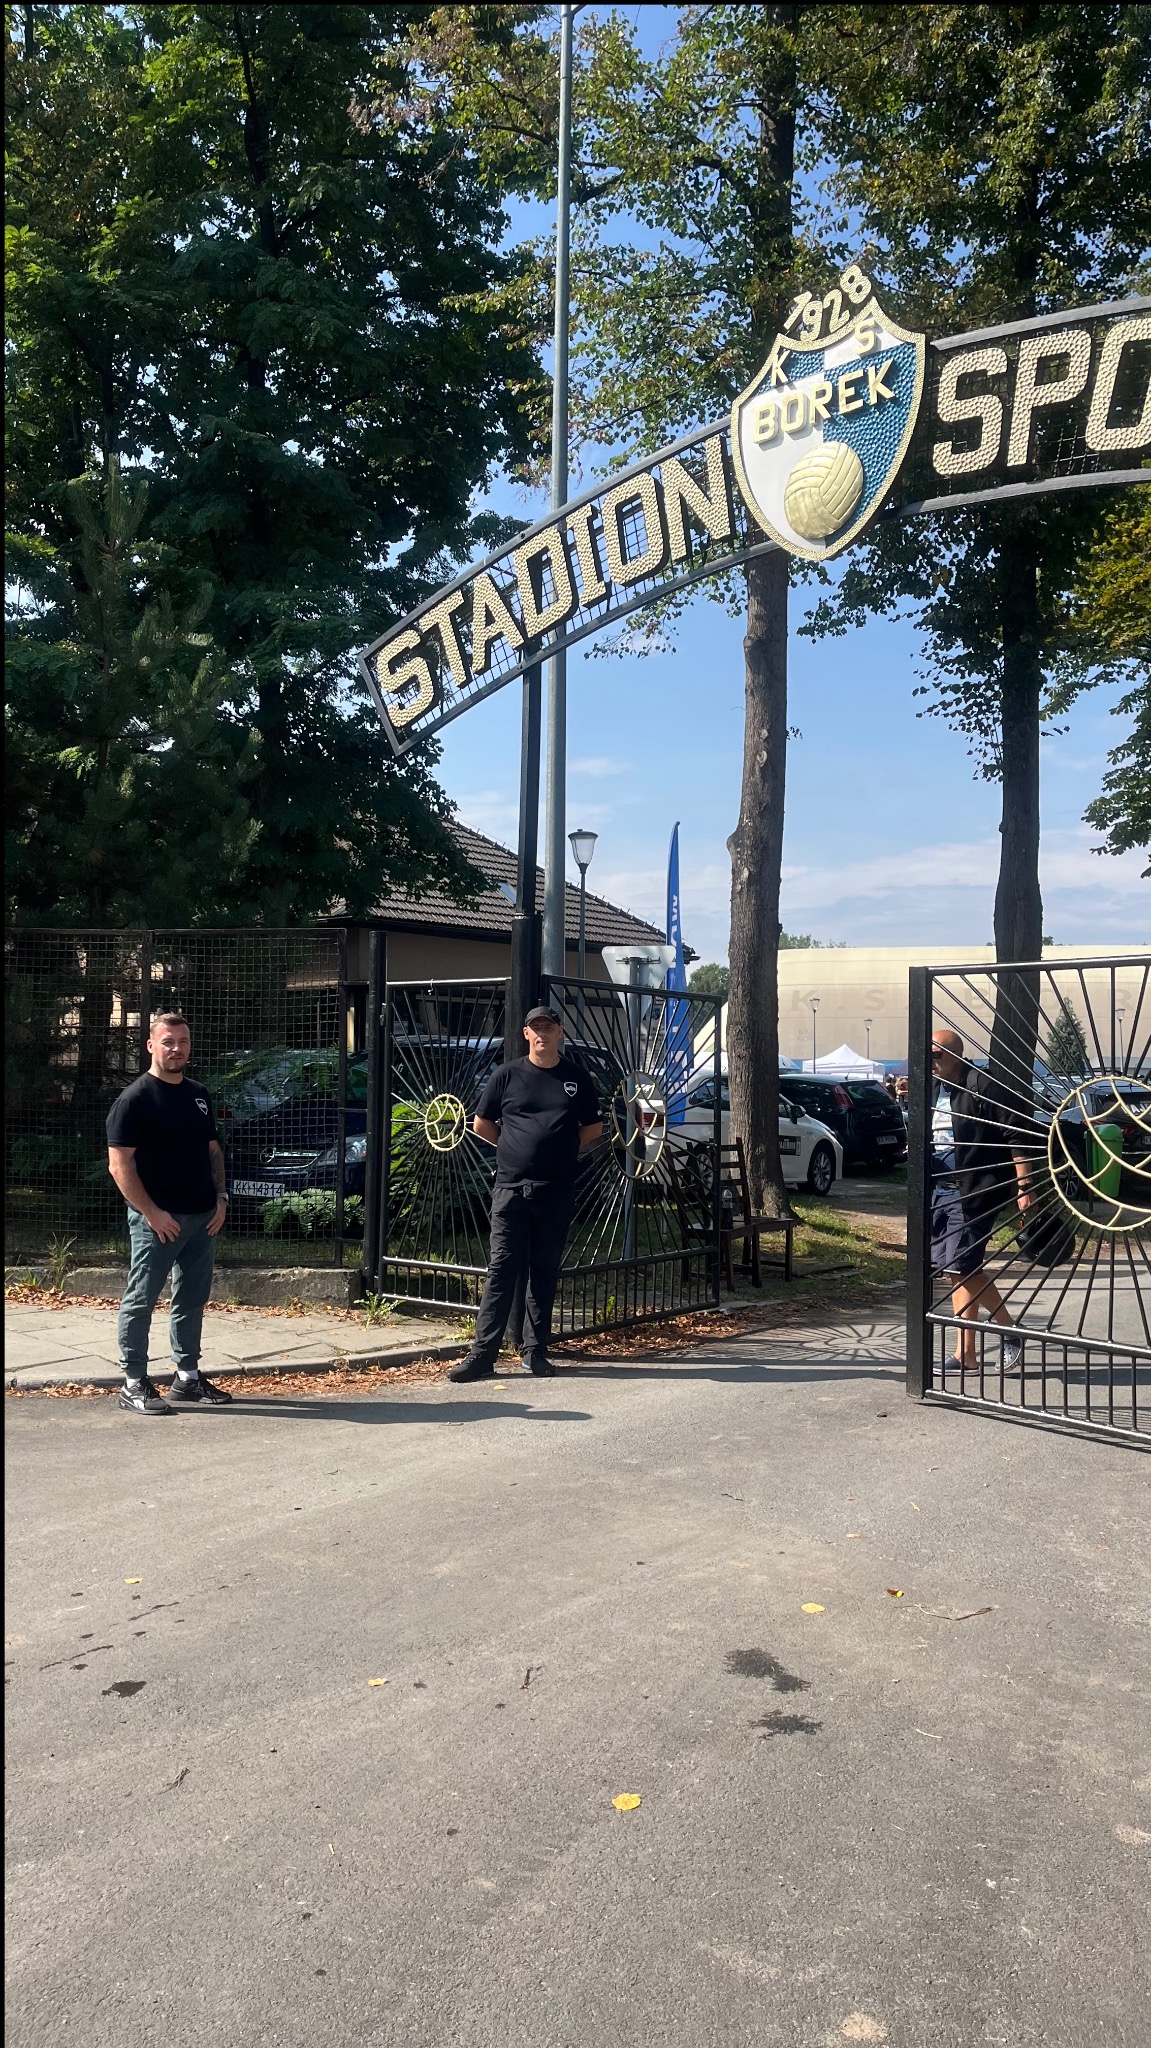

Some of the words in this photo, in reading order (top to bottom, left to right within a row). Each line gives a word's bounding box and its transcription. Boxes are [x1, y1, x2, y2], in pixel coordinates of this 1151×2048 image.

[782, 264, 872, 342] 1928
[771, 349, 788, 387] K
[854, 317, 877, 356] S
[752, 360, 895, 445] BOREK
[374, 434, 733, 729] STADION
[932, 317, 1151, 476] SPO
